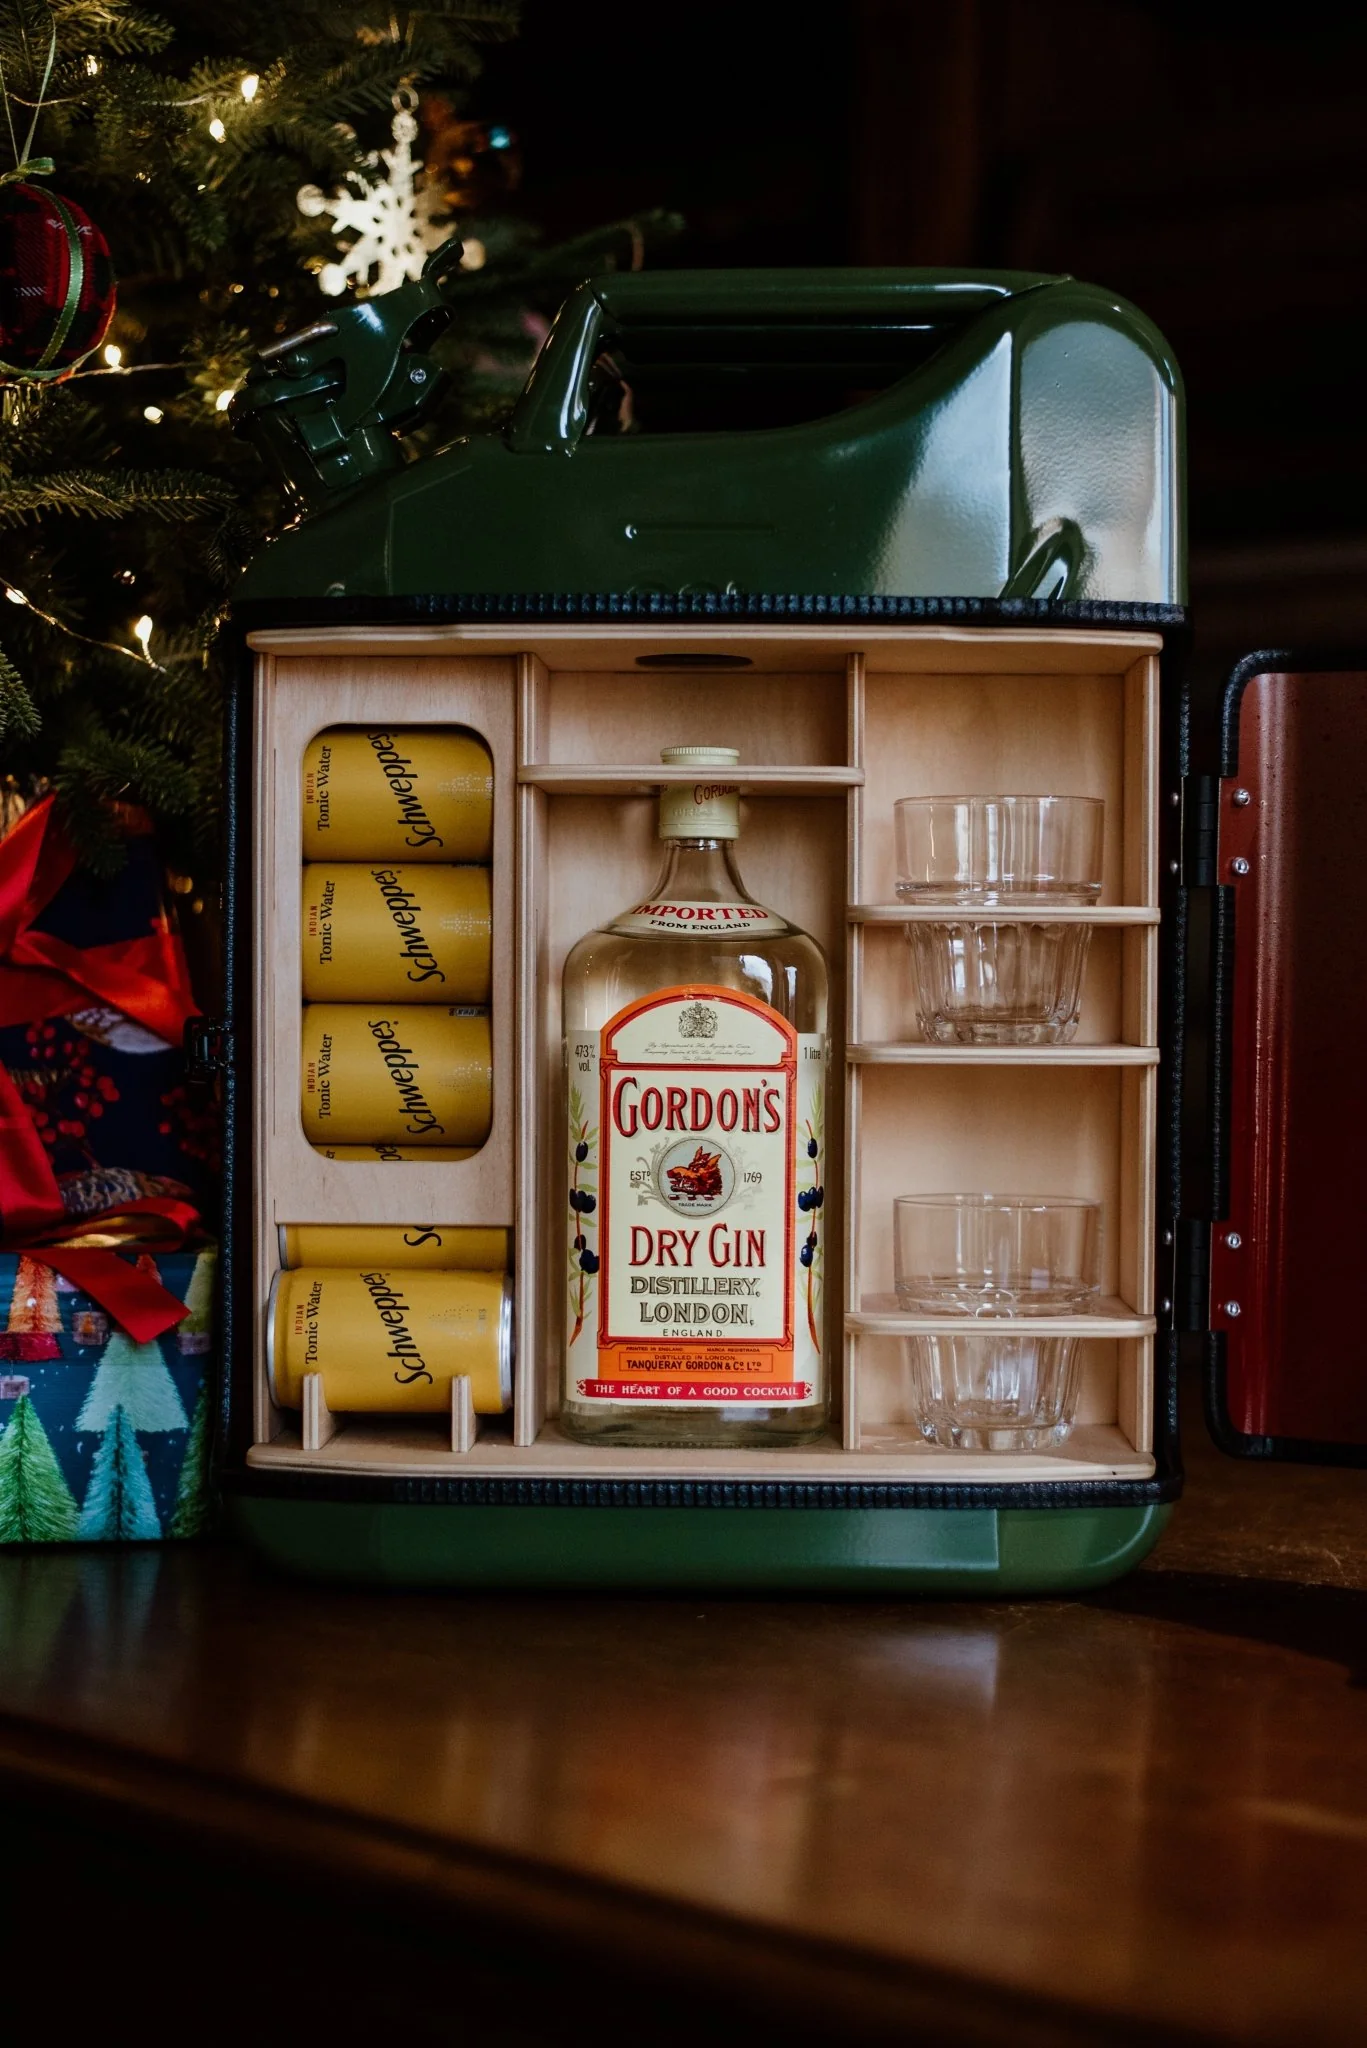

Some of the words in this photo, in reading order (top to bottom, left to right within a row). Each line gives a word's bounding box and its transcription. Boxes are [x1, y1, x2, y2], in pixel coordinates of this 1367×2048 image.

[317, 745, 332, 789] Water
[307, 772, 315, 804] INDIAN
[367, 731, 444, 847] Schweppes
[316, 790, 331, 831] Tonic
[309, 904, 318, 936] INDIAN
[320, 880, 335, 922] Water
[630, 903, 769, 922] IMPORTED
[318, 923, 333, 964] Tonic
[371, 869, 446, 983] Schweppes
[649, 918, 689, 931] FROM
[691, 921, 751, 931] ENGLAND
[318, 1033, 333, 1078] Water
[803, 1046, 808, 1060] 1
[809, 1046, 821, 1060] litre
[307, 1061, 316, 1093] INDIAN
[367, 1019, 446, 1135] Schweppes
[317, 1079, 332, 1119] Tonic
[612, 1076, 781, 1138] GORDON'S
[743, 1171, 763, 1184] 1769
[629, 1224, 700, 1268] DRY
[708, 1222, 767, 1269] GIN
[295, 1304, 305, 1335] INDIAN
[305, 1281, 323, 1319] Water
[304, 1321, 319, 1364] Tonic
[360, 1272, 434, 1385] Schweppes
[627, 1360, 683, 1371] TANQUERAY
[686, 1360, 723, 1370] GORDON
[724, 1362, 731, 1370] &
[594, 1384, 617, 1395] THE
[621, 1384, 660, 1396] HEART
[667, 1385, 682, 1395] OF
[687, 1386, 697, 1396] A
[702, 1386, 738, 1397] GOOD
[744, 1385, 800, 1398] COCKTAIL
